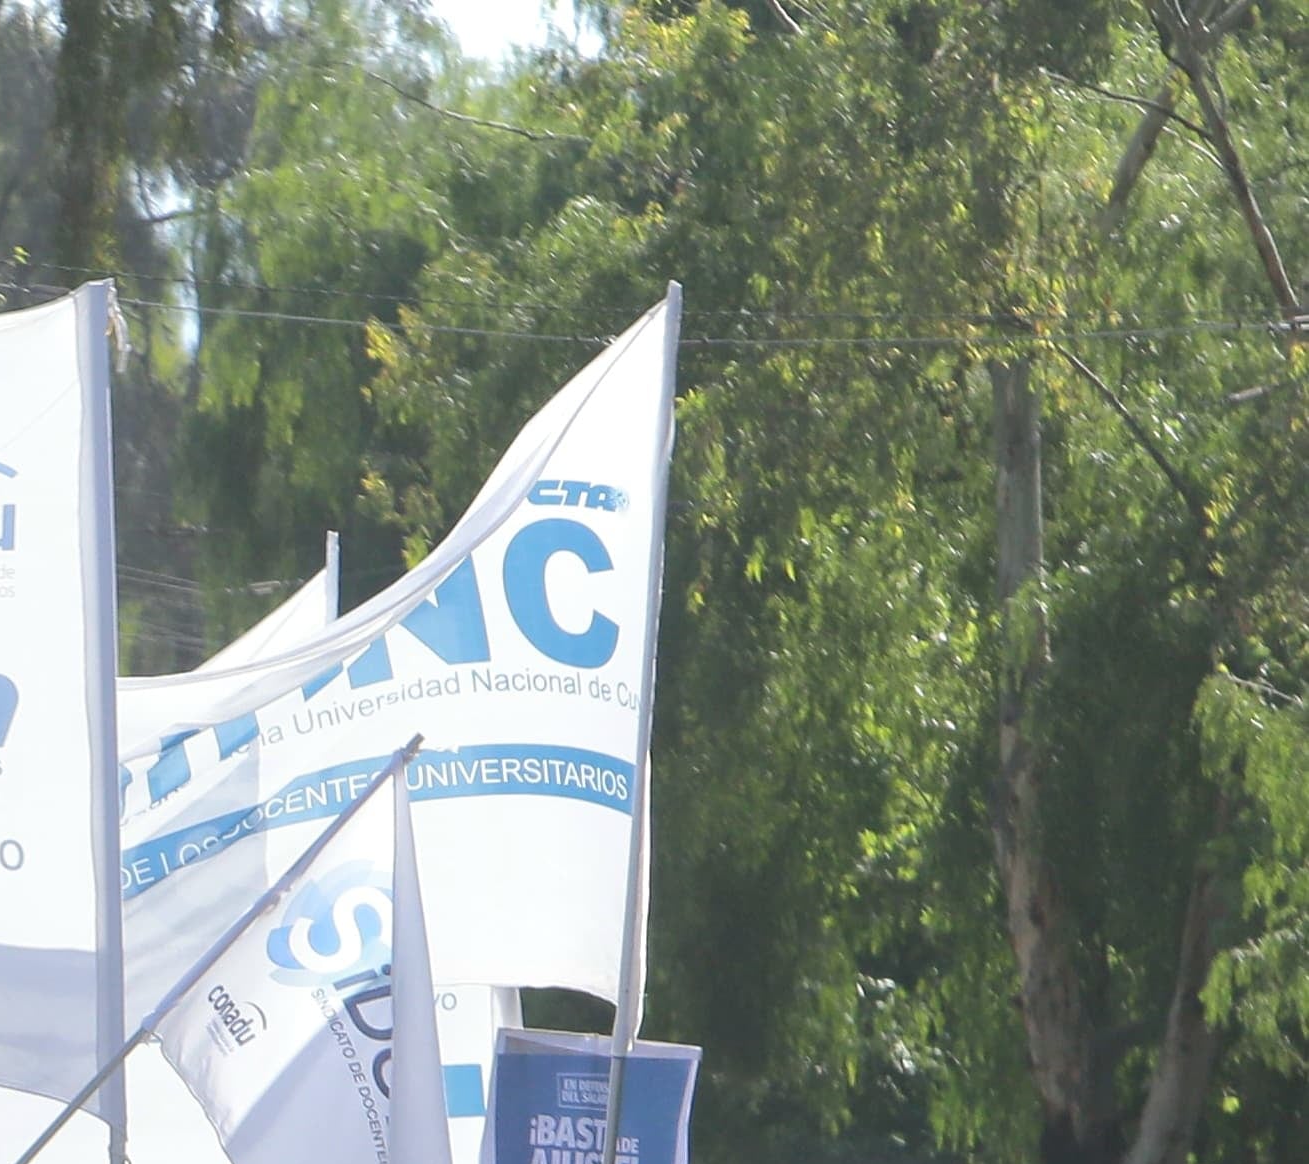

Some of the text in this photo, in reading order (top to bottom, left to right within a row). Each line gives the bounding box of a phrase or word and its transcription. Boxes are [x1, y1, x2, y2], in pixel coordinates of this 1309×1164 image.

[291, 670, 461, 737] Universidad
[470, 667, 583, 697] Nacional
[589, 676, 613, 702] de
[404, 757, 629, 800] UNIVERSITARIOS
[208, 984, 255, 1046] conadu
[348, 1061, 367, 1084] DE
[530, 1114, 640, 1154] ¡BAST DE
